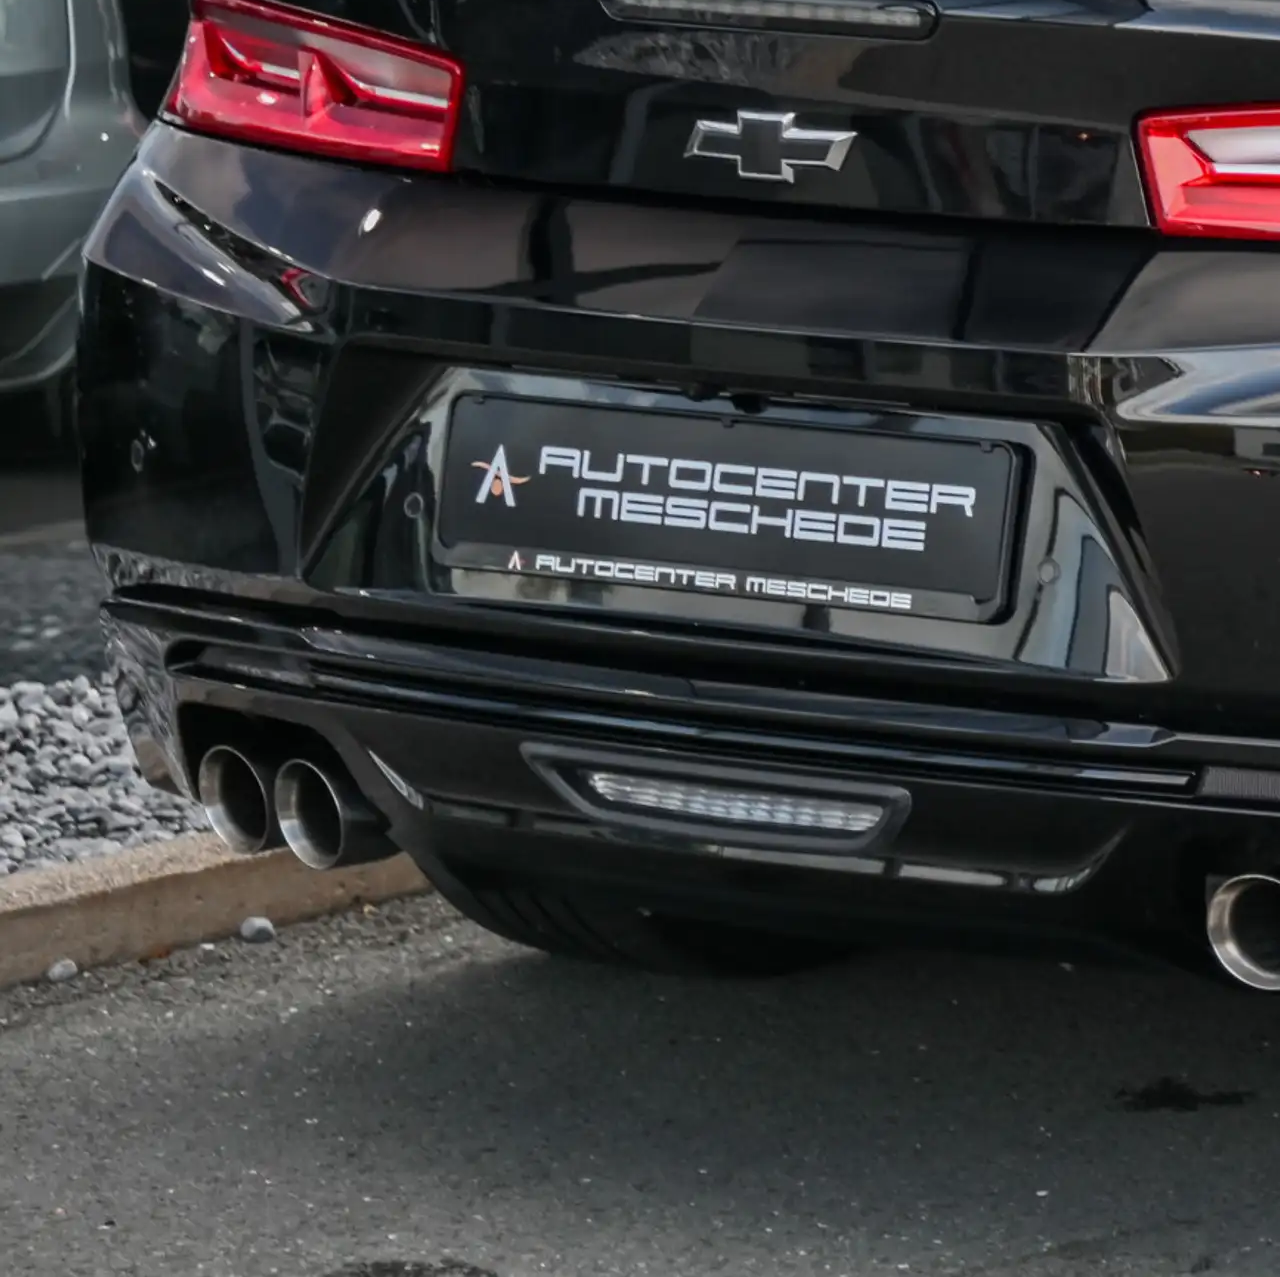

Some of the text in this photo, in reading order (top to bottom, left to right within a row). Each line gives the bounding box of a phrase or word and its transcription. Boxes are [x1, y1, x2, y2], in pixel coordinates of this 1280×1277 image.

[538, 445, 977, 518] AUTOCENTER
[576, 487, 927, 552] MESCHEDE
[535, 553, 736, 591] AUTOCENTER
[745, 575, 913, 610] MESCHEDE
